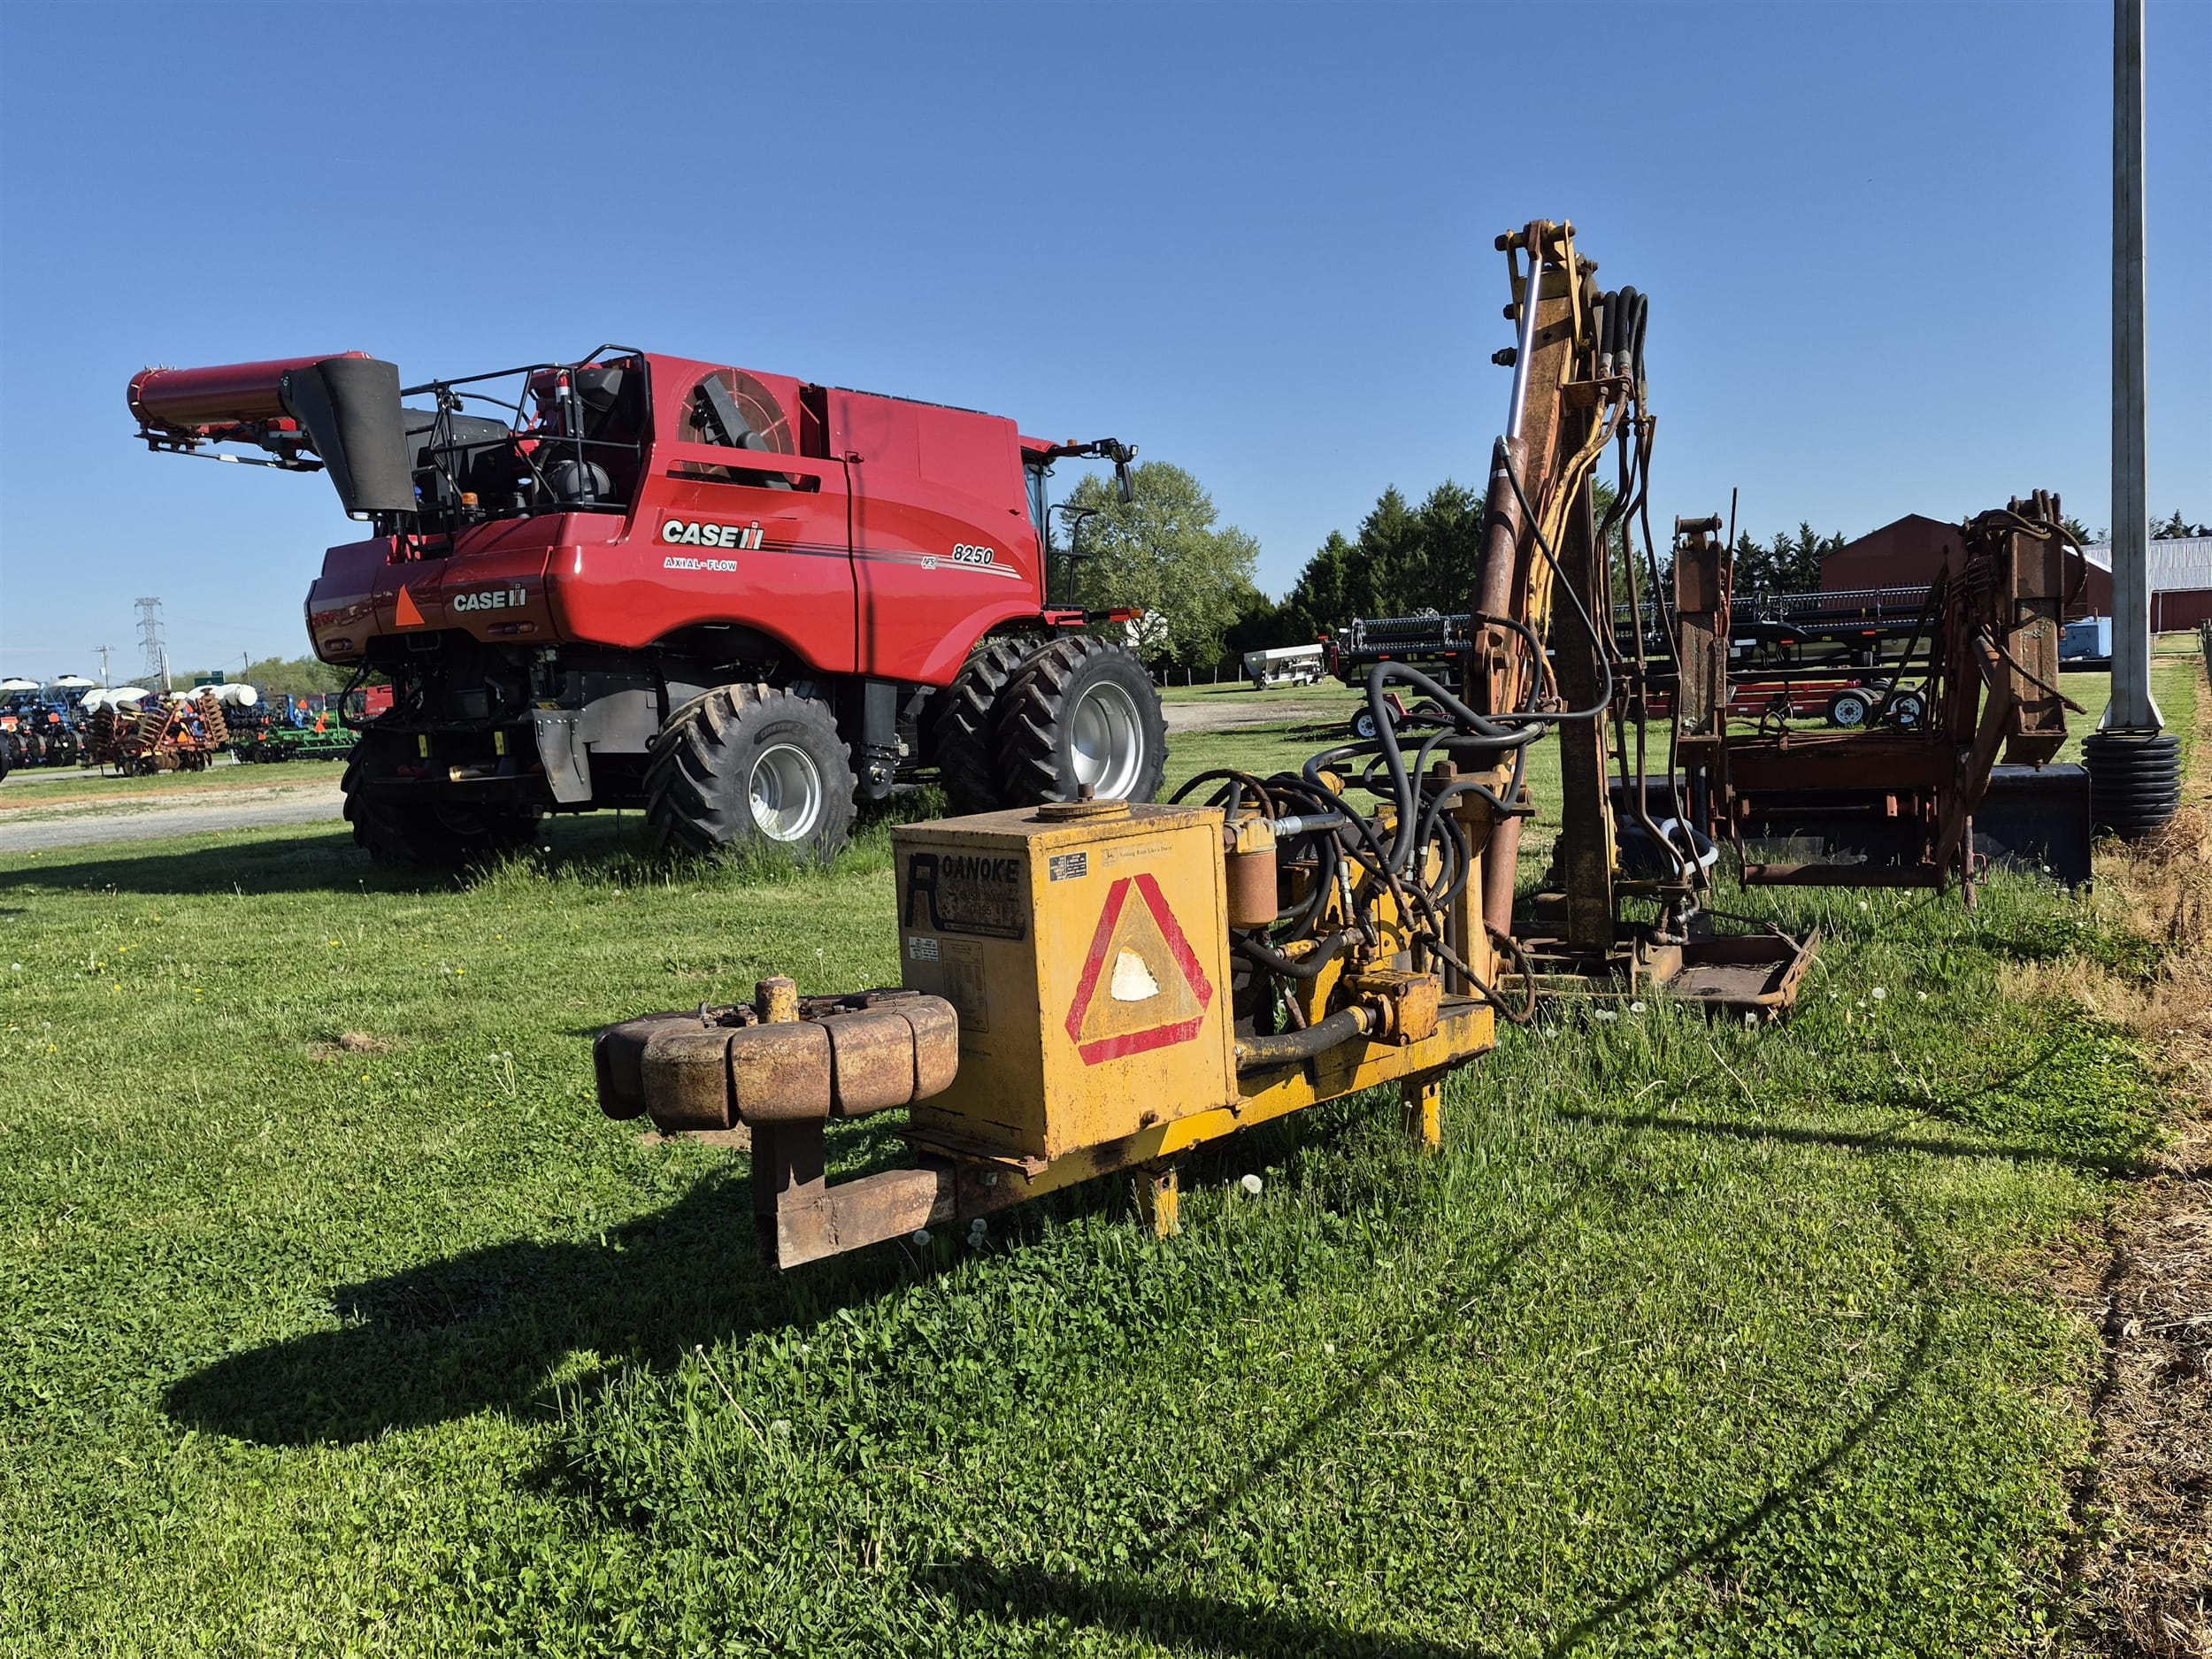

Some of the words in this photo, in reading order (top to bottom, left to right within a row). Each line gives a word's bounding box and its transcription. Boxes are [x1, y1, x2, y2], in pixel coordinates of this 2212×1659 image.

[662, 519, 739, 548] CASE
[664, 557, 737, 572] AXIAL-FLOW
[953, 544, 994, 565] 8250
[453, 591, 505, 611] CASE
